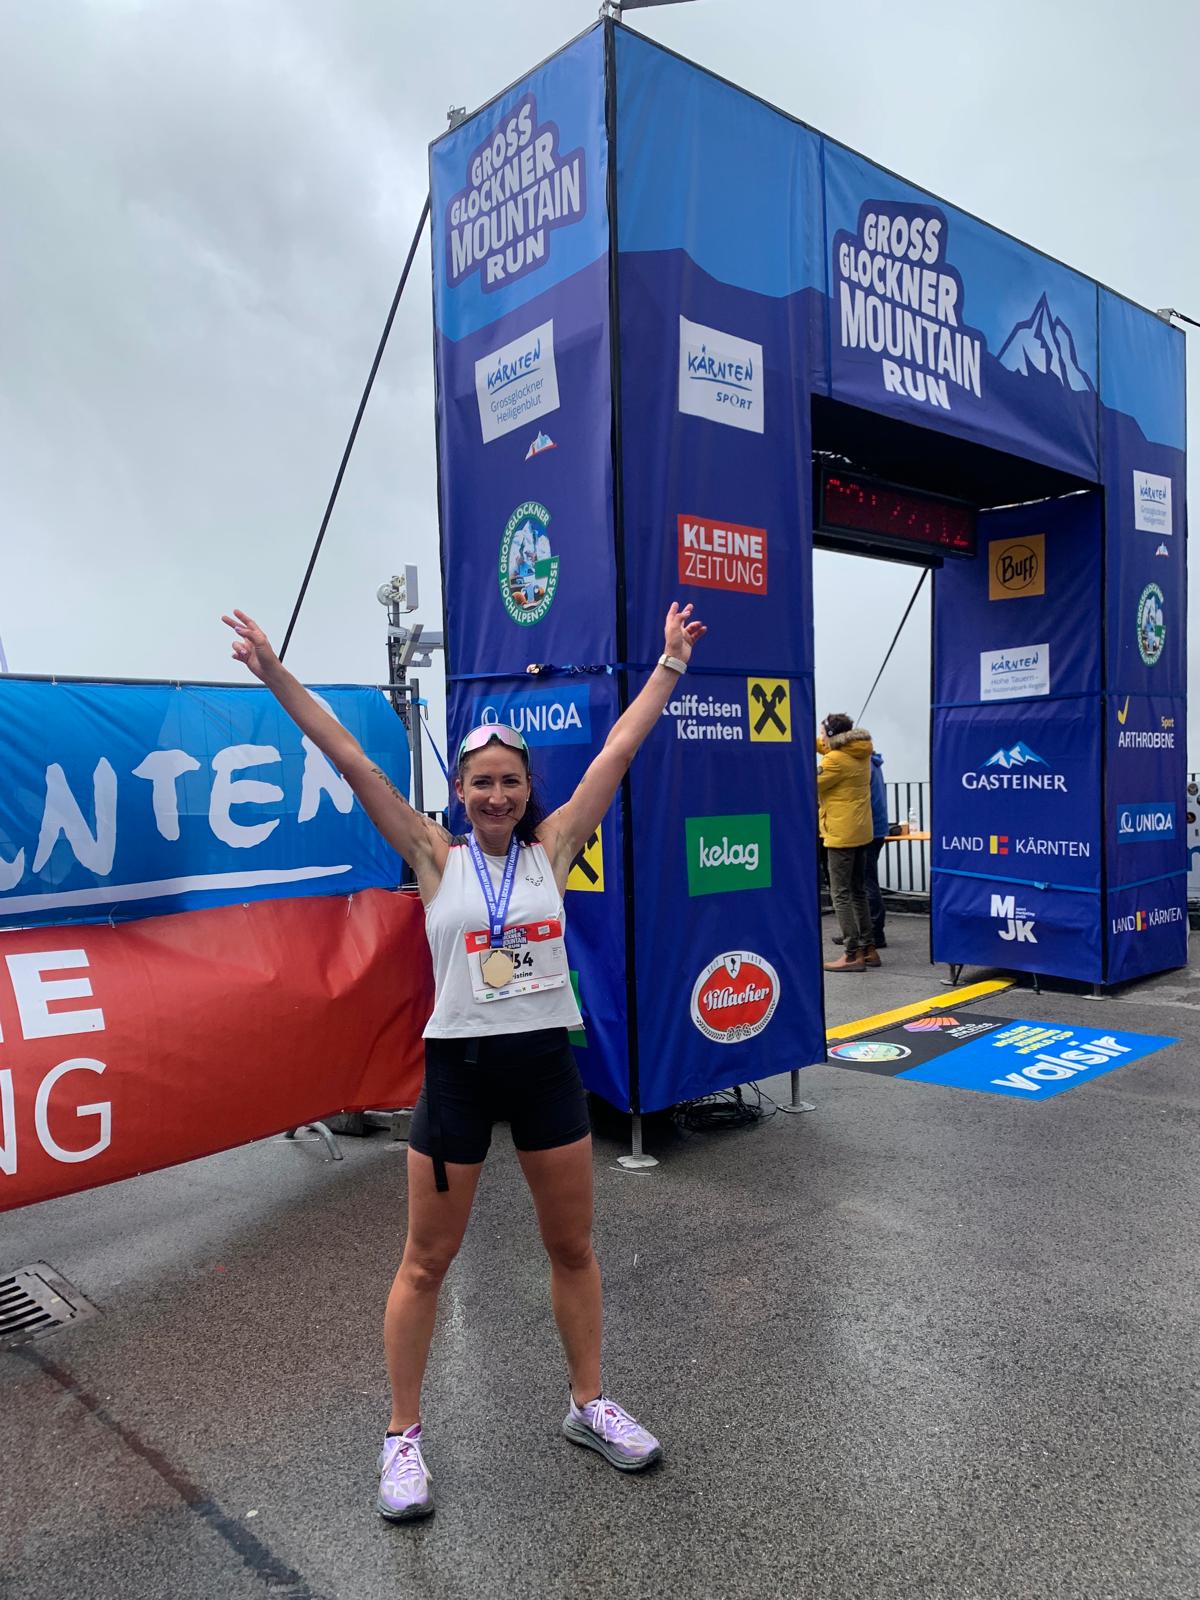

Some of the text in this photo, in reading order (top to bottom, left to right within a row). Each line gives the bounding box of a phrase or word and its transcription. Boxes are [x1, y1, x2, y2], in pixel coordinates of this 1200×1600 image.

[471, 103, 532, 187] GROSS
[451, 131, 556, 226] GLOCKNER
[451, 158, 580, 278] MOUNTAIN
[863, 212, 942, 264] GROSS
[486, 229, 545, 284] RUN
[839, 241, 958, 327] GLOCKNER
[840, 280, 981, 398] MOUNTAIN
[490, 378, 544, 412] Grossglockner
[716, 391, 752, 410] SPORT
[882, 358, 951, 410] RUN
[496, 394, 542, 424] Heiligenblut
[500, 503, 550, 573] GROSSGLOCKNER
[683, 523, 763, 559] KLEINE
[684, 552, 763, 586] ZEITUNG
[510, 702, 582, 732] UNIQA
[677, 719, 743, 740] Kärnten
[1118, 731, 1175, 748] ARTHROBENE
[1135, 812, 1173, 832] UNIQA
[699, 836, 759, 871] kelag
[942, 836, 1090, 857] LAND KÄRNTEN
[1112, 915, 1135, 934] LAND
[990, 1035, 1132, 1091] valsir
